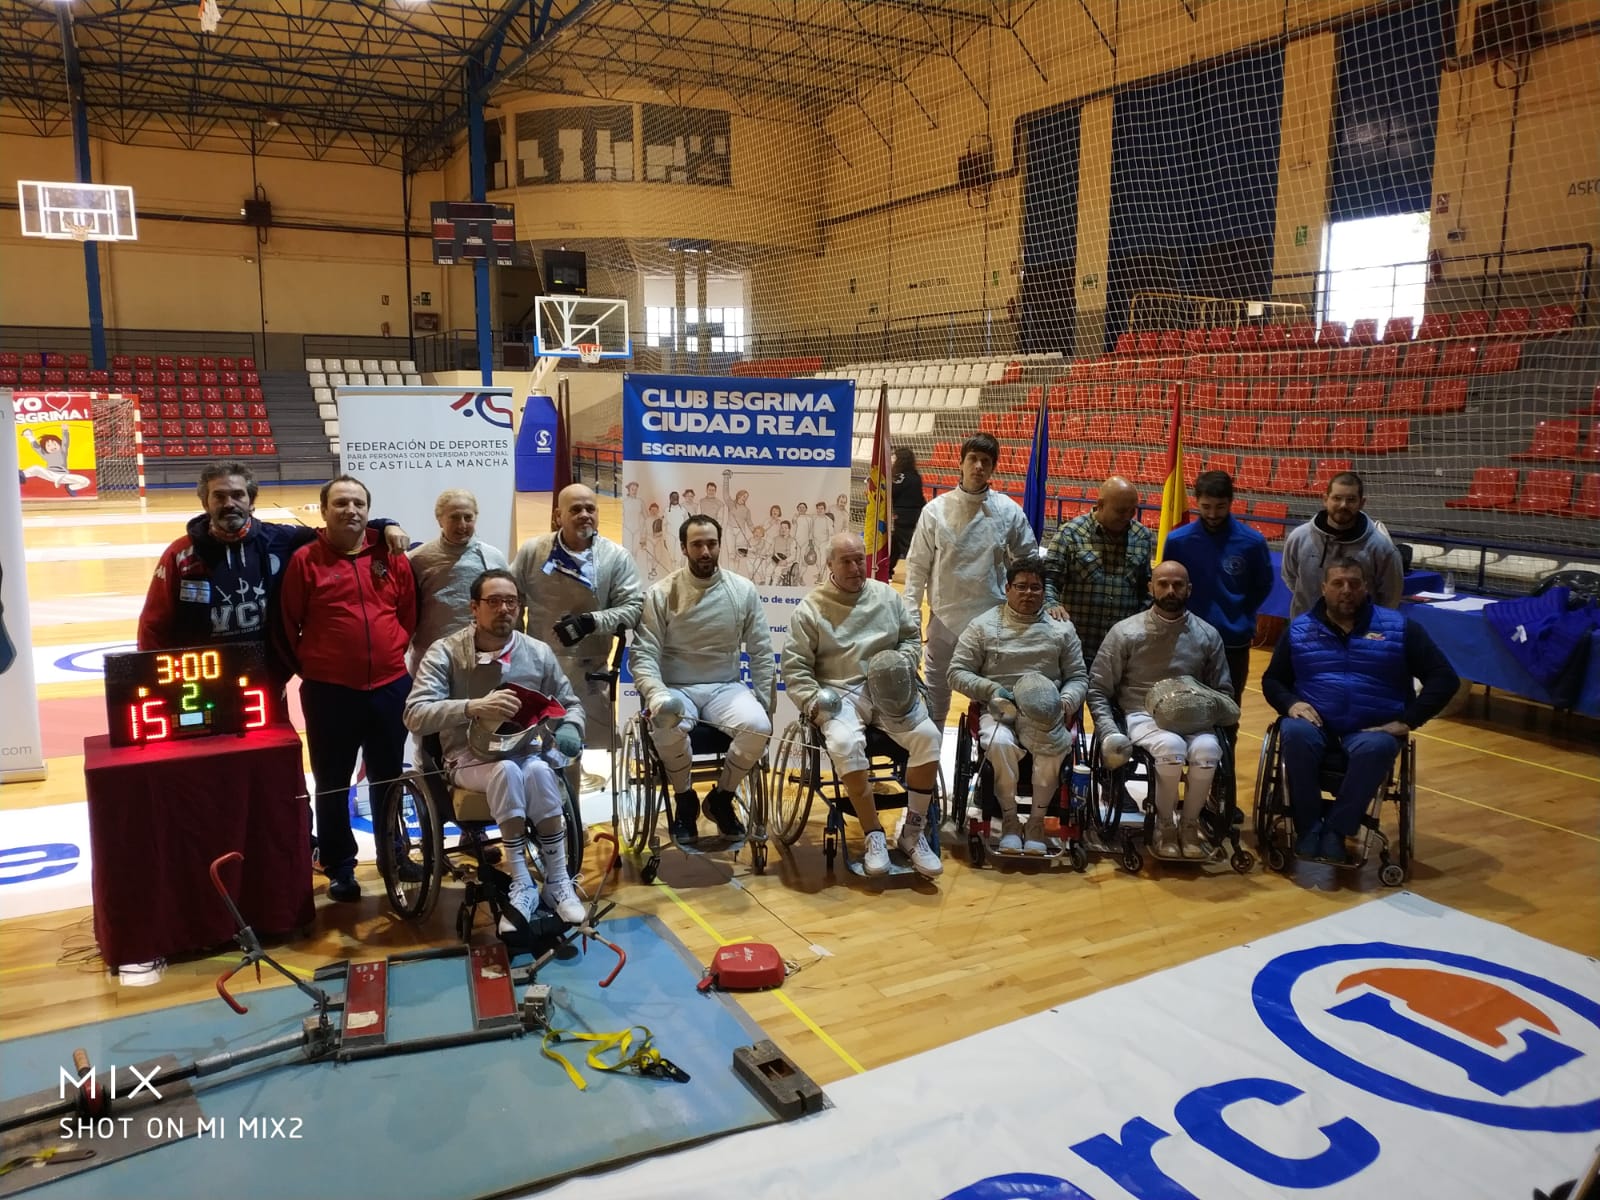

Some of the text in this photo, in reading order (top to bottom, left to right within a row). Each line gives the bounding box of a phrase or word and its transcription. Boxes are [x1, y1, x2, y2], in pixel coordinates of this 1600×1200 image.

[13, 397, 43, 412] YO
[641, 388, 836, 413] CLUB ESGRIMA
[15, 409, 89, 424] SGRIMA!
[641, 411, 836, 437] CIUDAD REAL
[346, 439, 508, 452] FEDERACIÓN DE DEPORTES
[369, 452, 408, 460] PERSONAS
[470, 450, 509, 458] FUNCIONAL
[641, 442, 836, 461] ESGRIMA PARA TODOS
[348, 458, 509, 471] DE CASTILLA LA MANCHA
[156, 651, 220, 684] 3:00
[182, 683, 198, 711] 2
[130, 700, 167, 740] 15
[243, 690, 266, 728] 3
